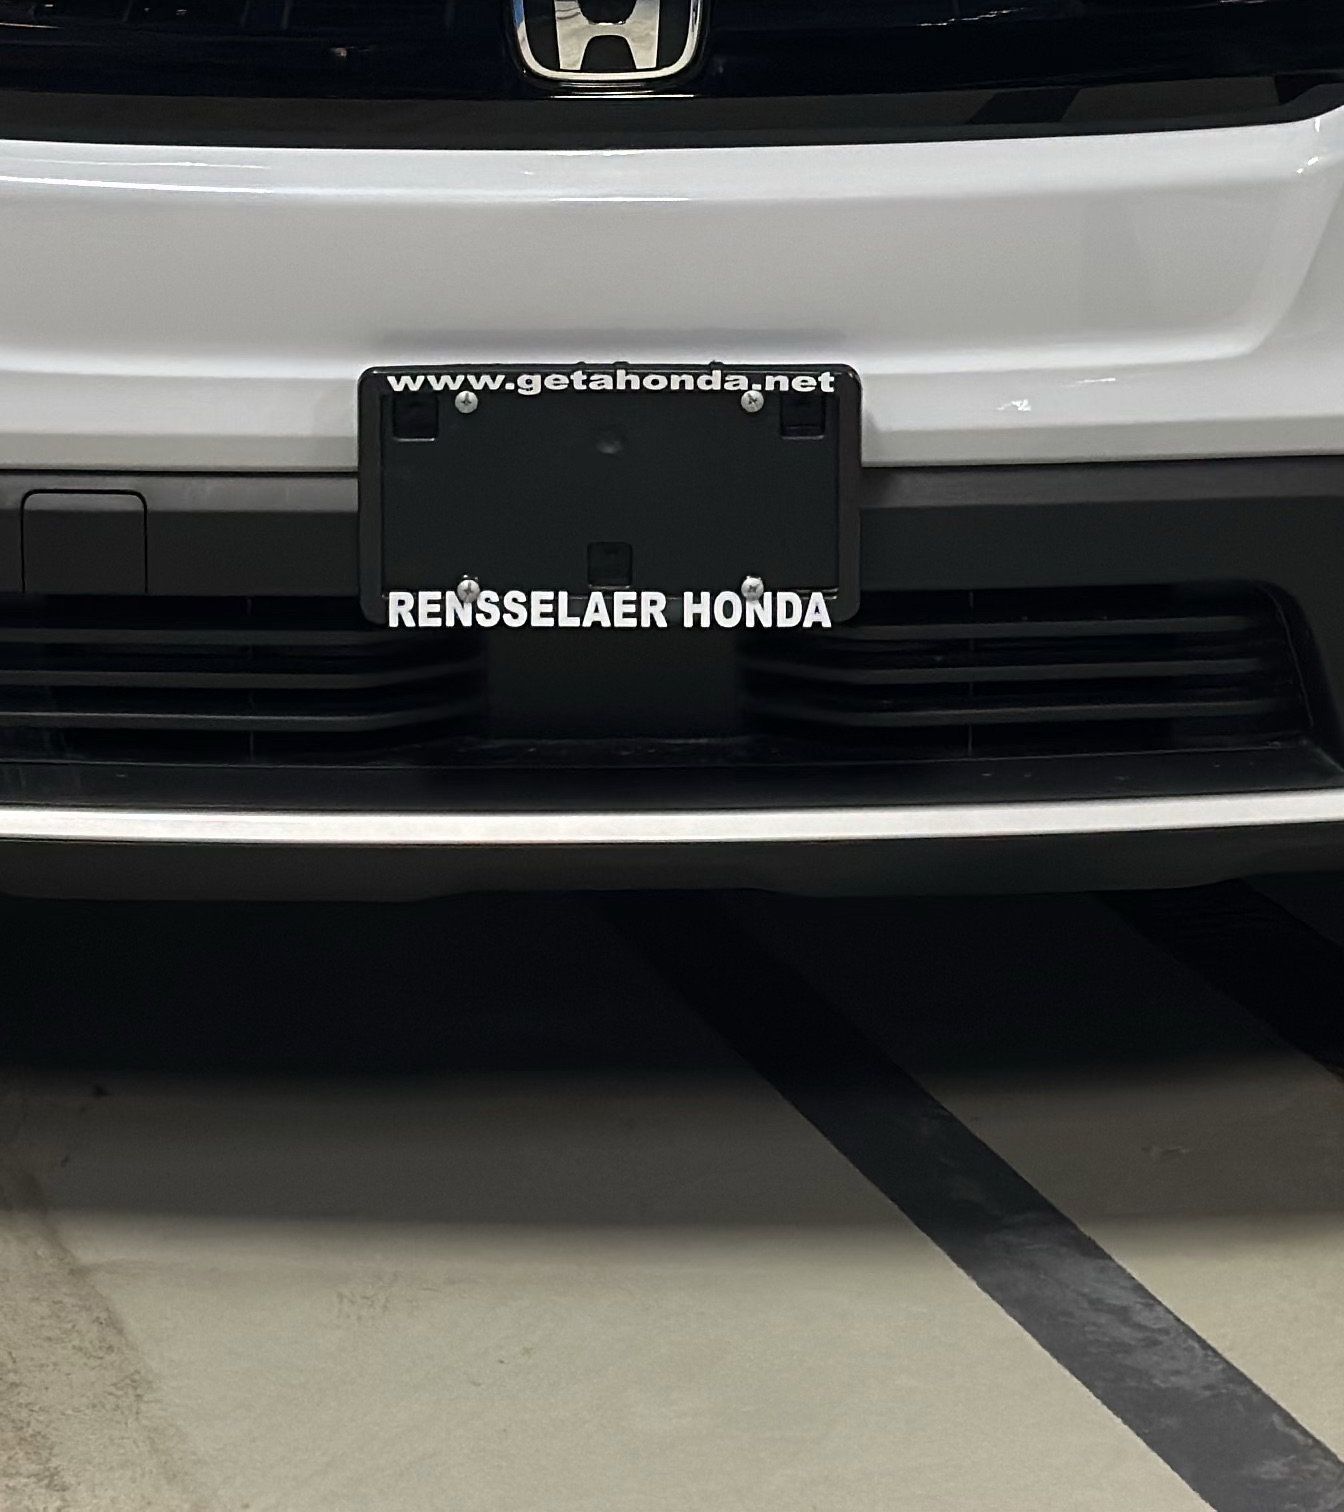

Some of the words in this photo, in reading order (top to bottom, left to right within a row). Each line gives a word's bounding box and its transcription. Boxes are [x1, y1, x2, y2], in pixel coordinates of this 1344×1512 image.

[386, 369, 835, 396] www.getahonda.net
[388, 590, 667, 628] RENSSELAER
[683, 590, 832, 628] HONDA
